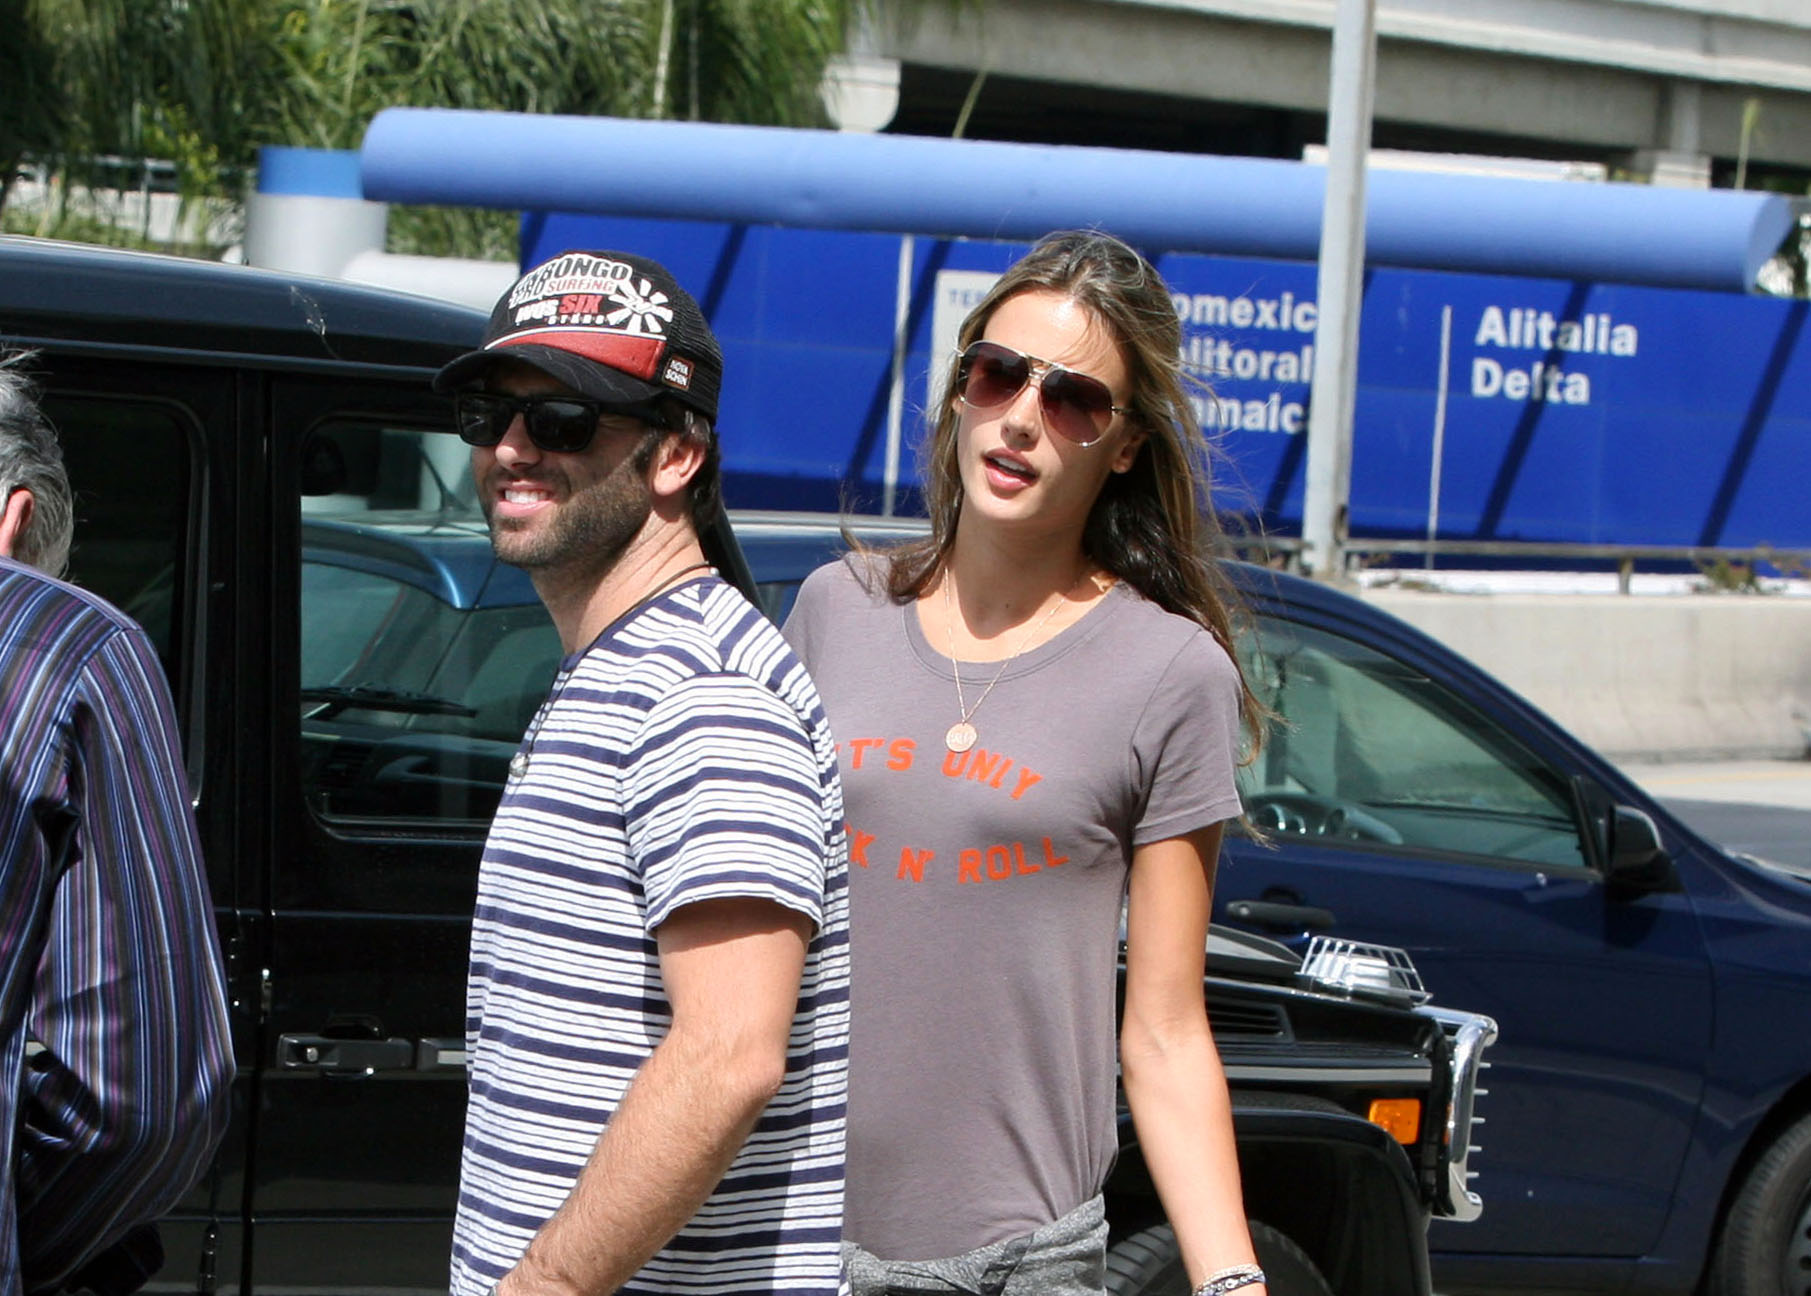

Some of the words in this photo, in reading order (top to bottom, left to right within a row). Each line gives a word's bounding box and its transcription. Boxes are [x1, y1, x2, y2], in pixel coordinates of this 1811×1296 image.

[560, 293, 604, 314] SIX
[1475, 305, 1638, 357] Alitalia
[1471, 356, 1591, 405] Delta
[941, 748, 1043, 801] ONLY
[844, 821, 876, 869] K
[957, 836, 1070, 885] ROLL
